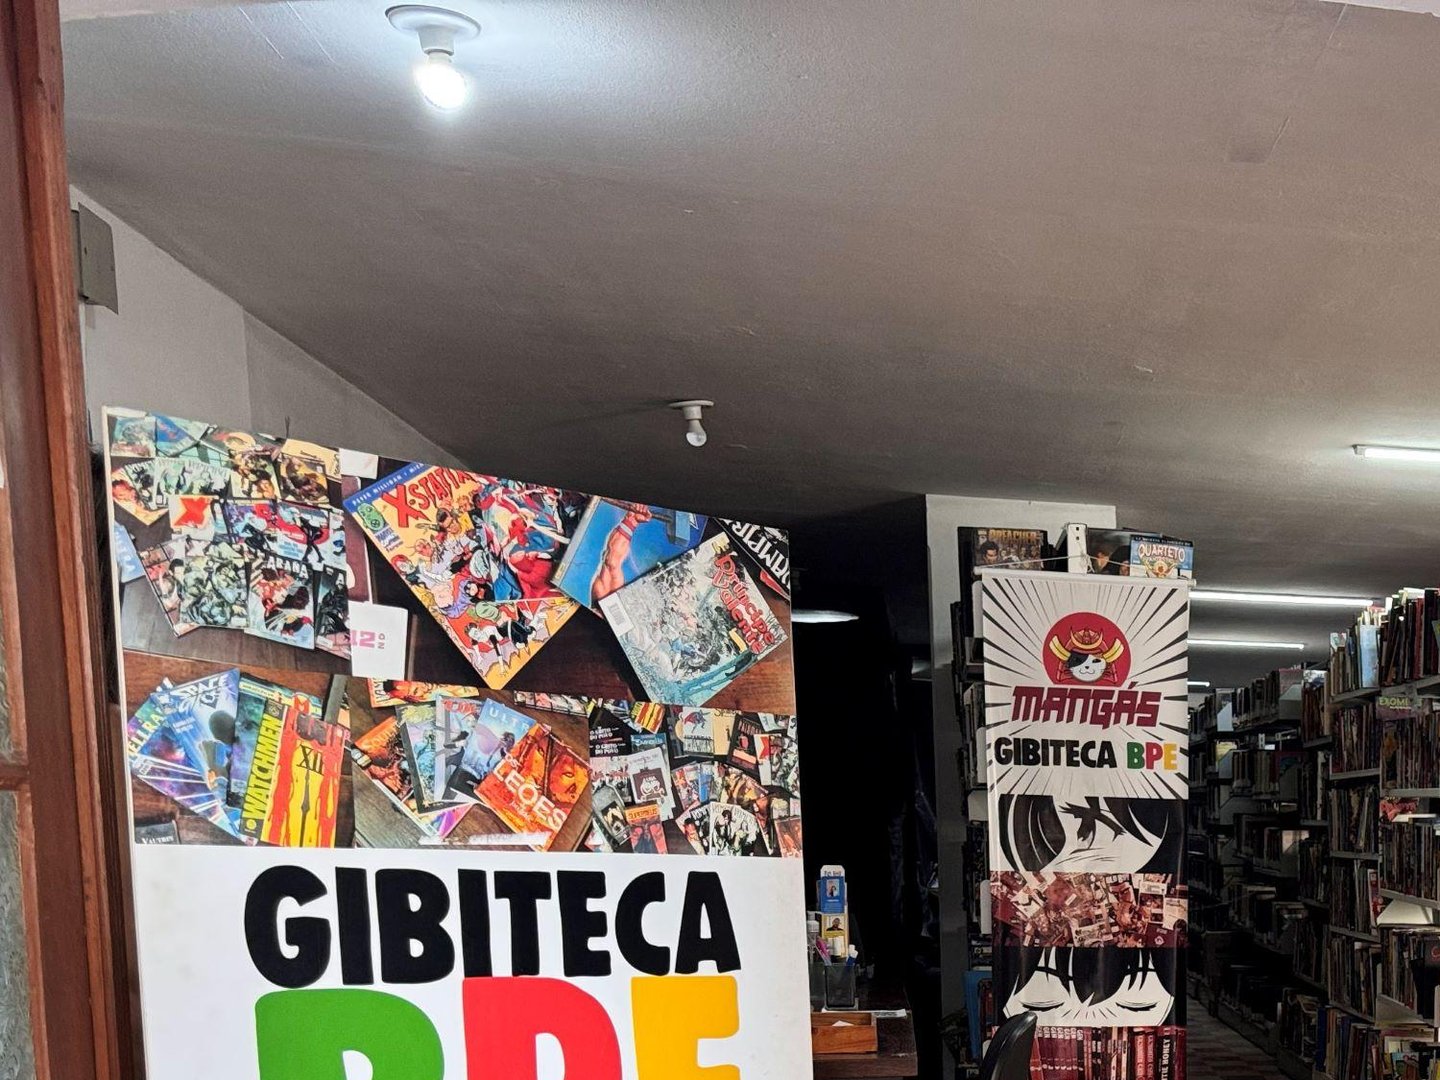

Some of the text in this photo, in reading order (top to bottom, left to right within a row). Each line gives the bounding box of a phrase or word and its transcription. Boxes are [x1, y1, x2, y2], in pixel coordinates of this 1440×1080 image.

[1138, 543, 1185, 562] QUARTETO
[1011, 682, 1162, 730] MANGÁS
[242, 712, 284, 821] WATCHMEN
[994, 736, 1178, 771] GIBITECA BPE
[244, 865, 741, 989] GIBITECA
